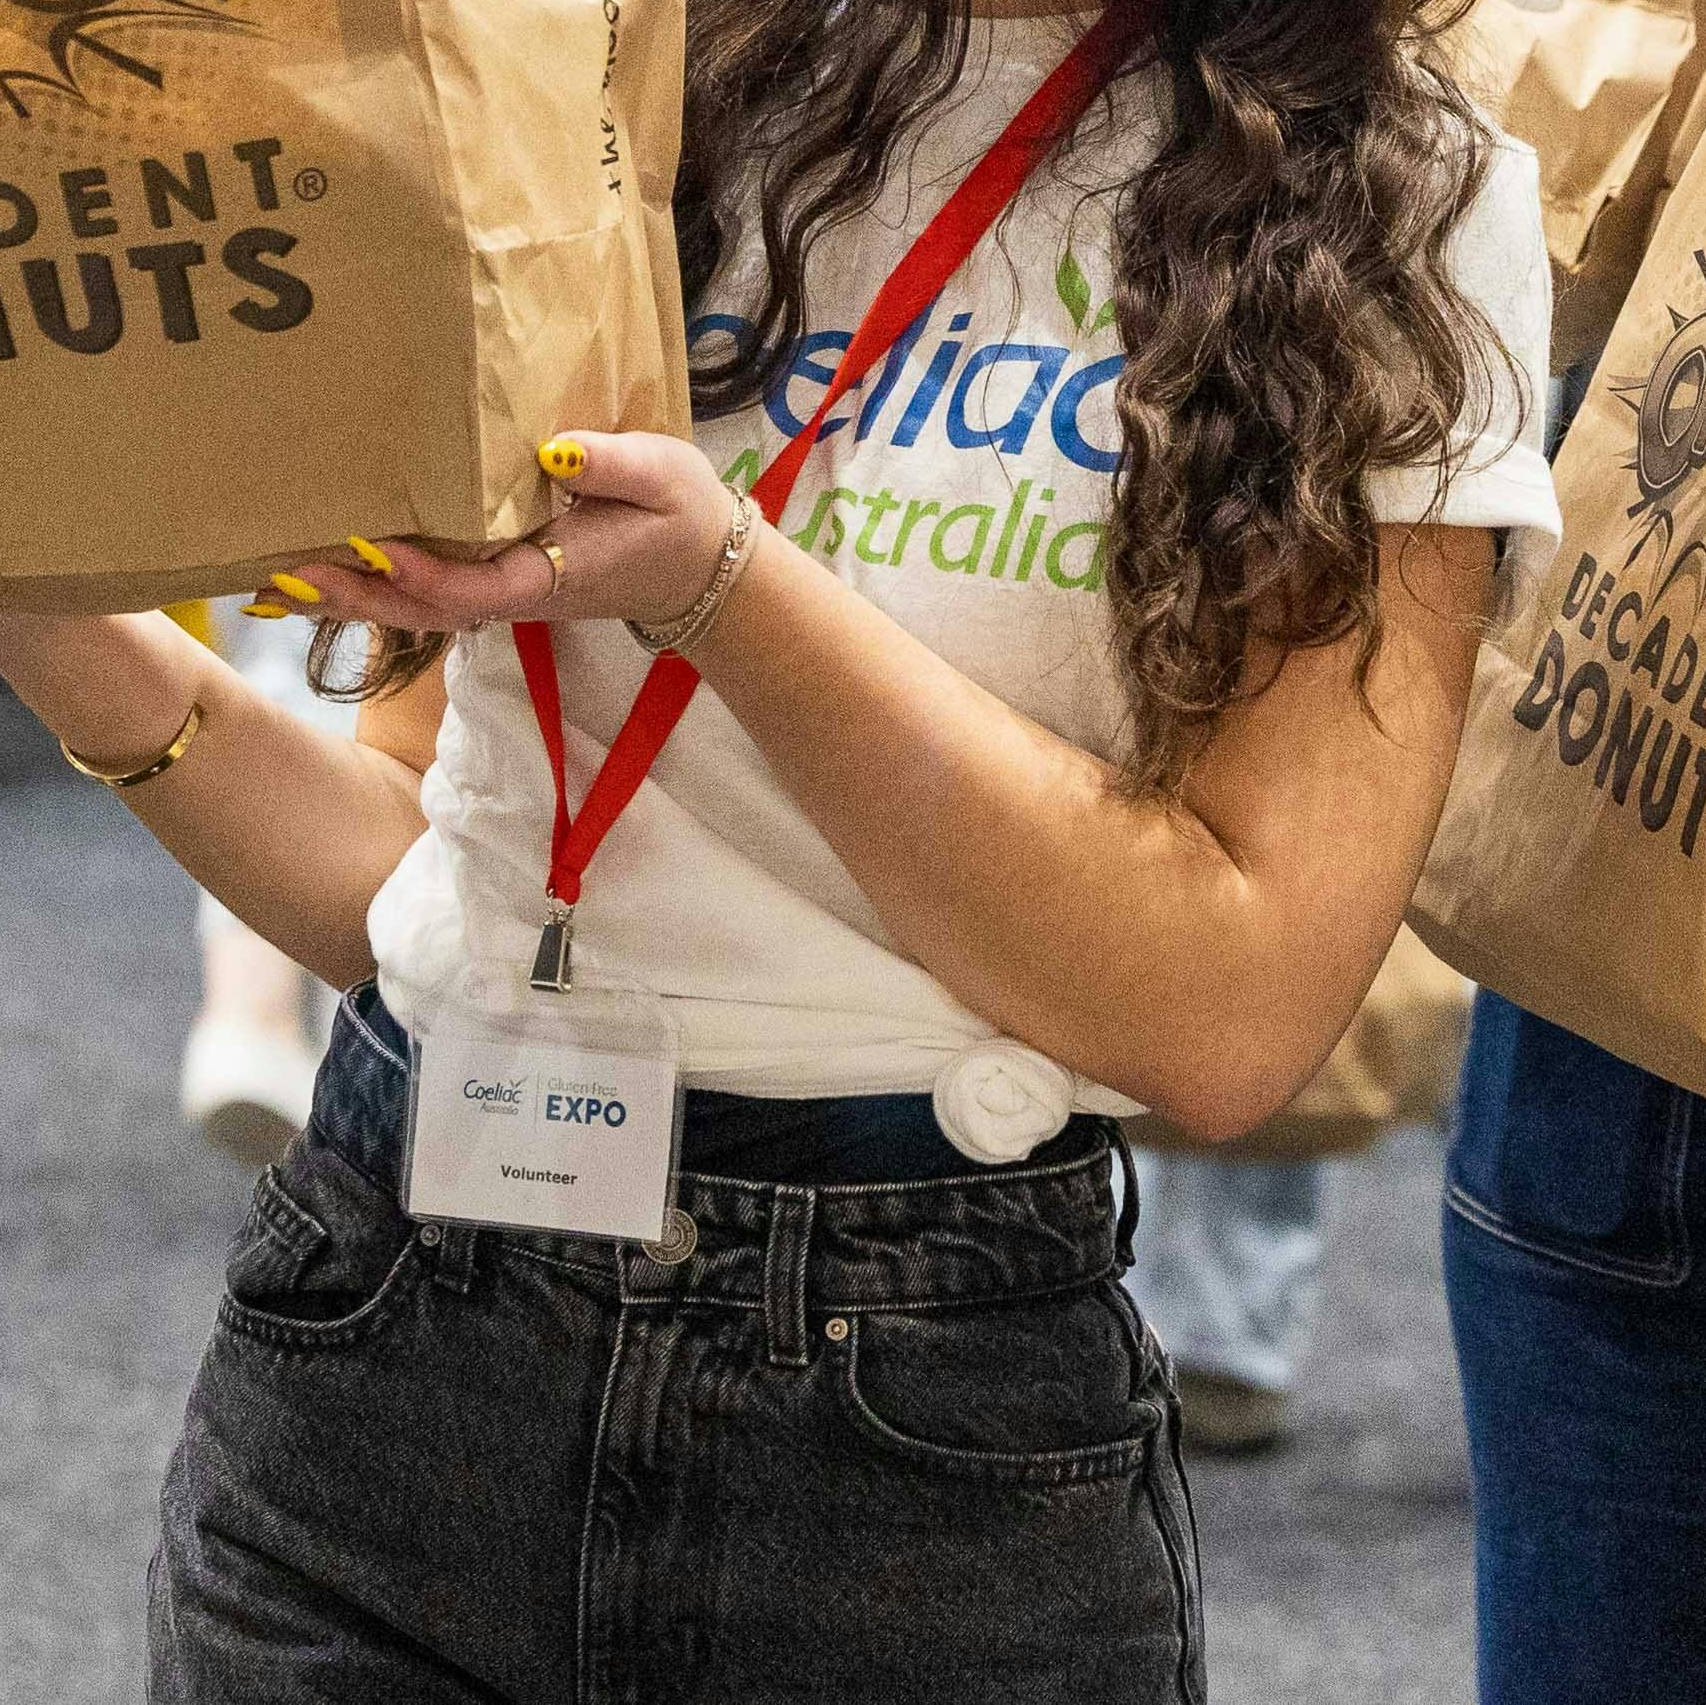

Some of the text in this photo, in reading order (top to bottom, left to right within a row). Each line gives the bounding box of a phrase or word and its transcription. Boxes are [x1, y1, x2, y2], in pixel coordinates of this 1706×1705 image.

[688, 284, 1131, 474] oeliac
[463, 1079, 523, 1105] Coeliac
[546, 1094, 627, 1128] EXPO
[500, 1164, 579, 1186] Volunteer
